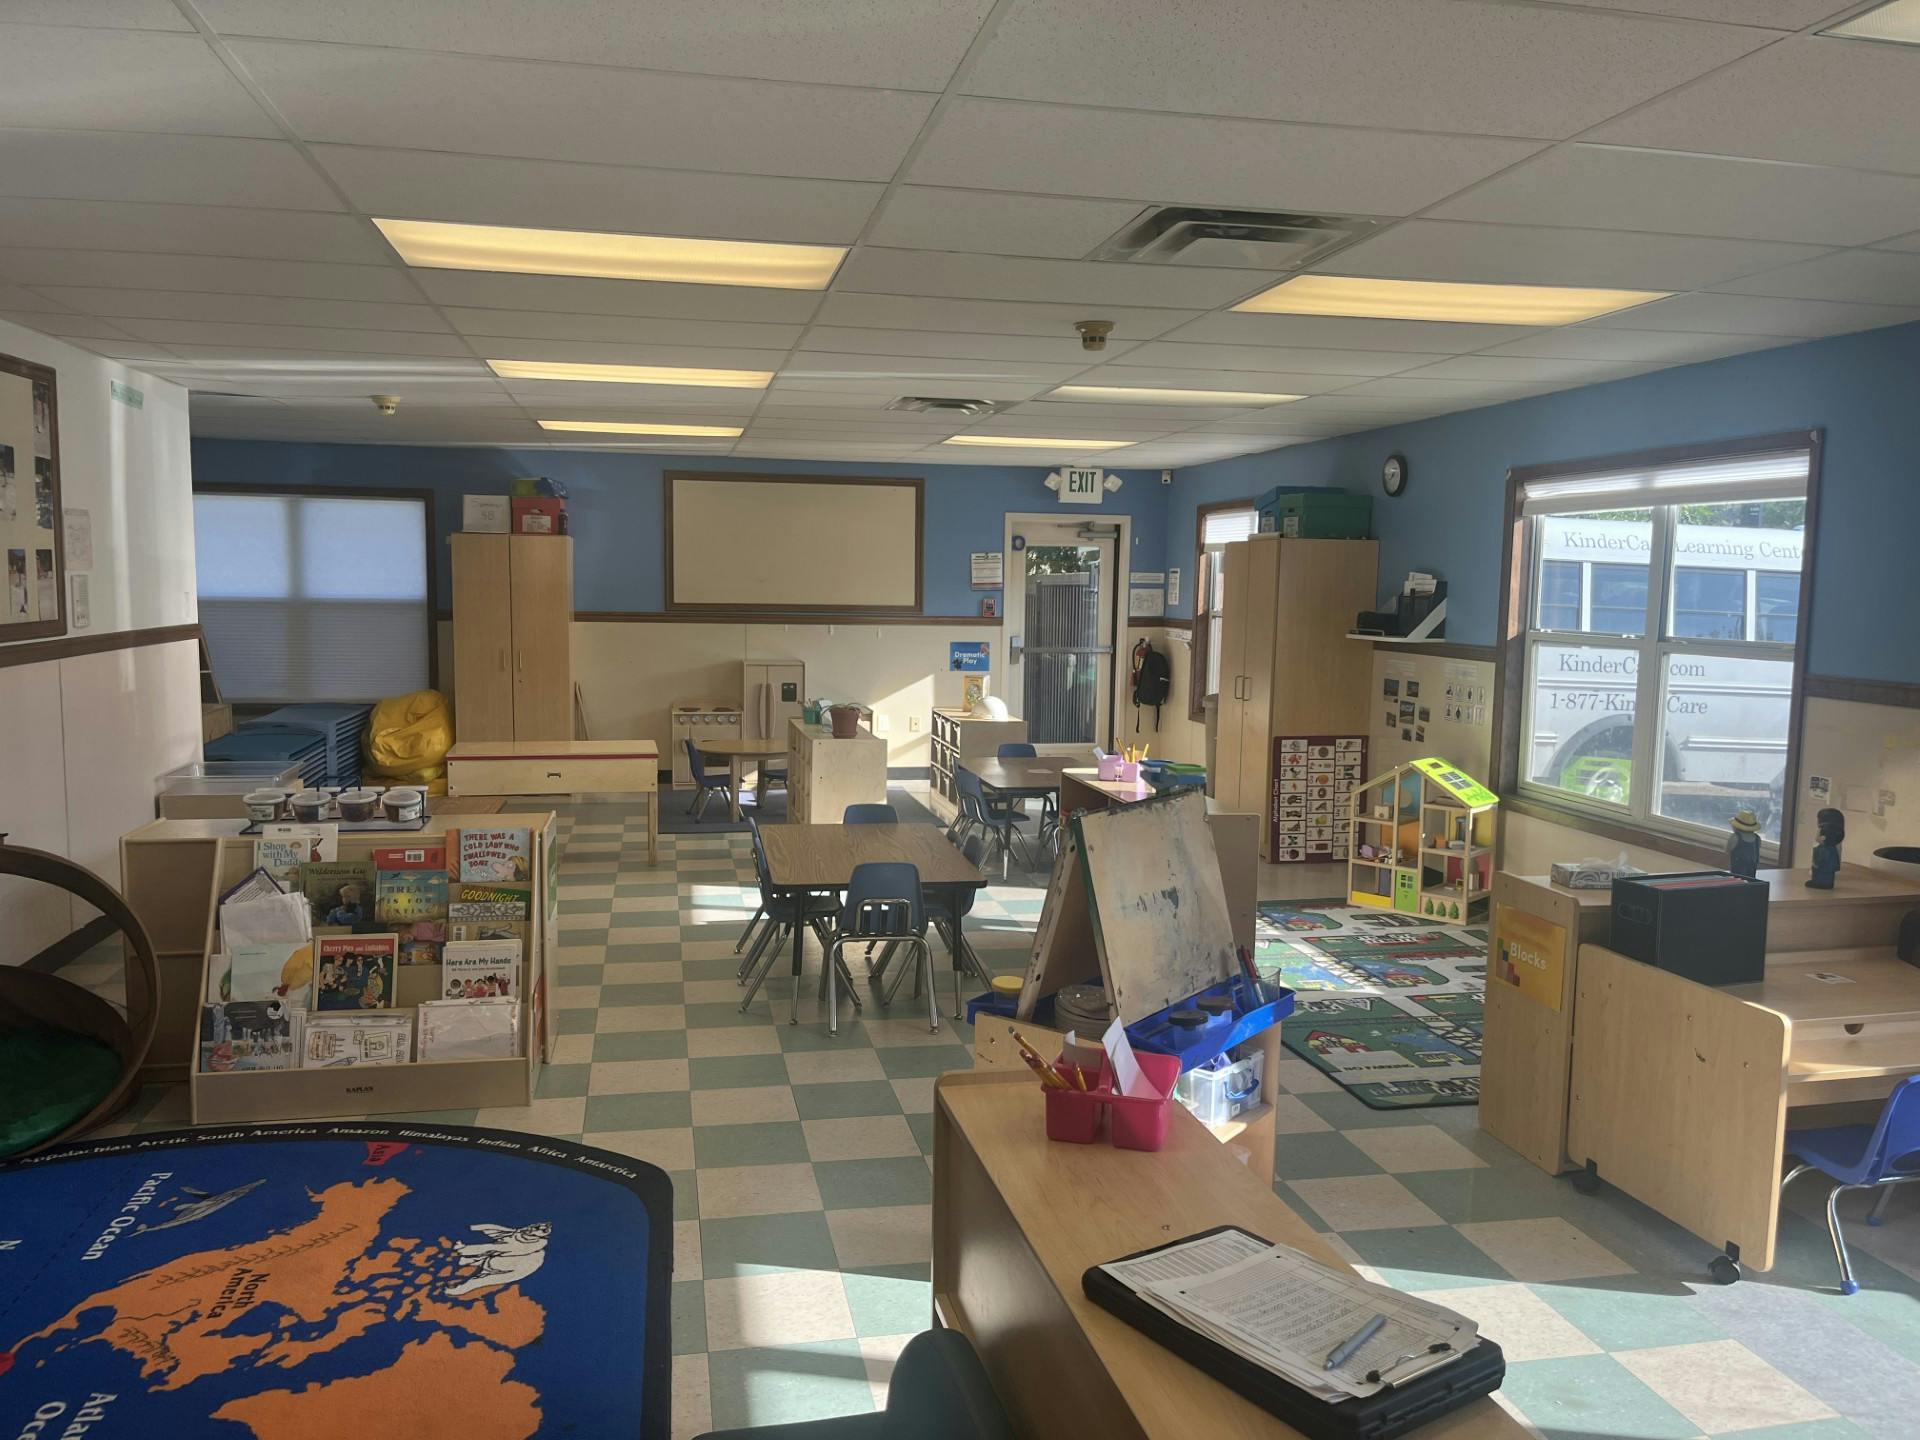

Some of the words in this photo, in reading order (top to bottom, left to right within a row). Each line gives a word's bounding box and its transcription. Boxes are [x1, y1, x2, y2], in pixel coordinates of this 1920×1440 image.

[1069, 471, 1096, 493] EXIT
[1563, 531, 1650, 551] KinderCa
[1675, 539, 1753, 560] Learning
[1760, 541, 1800, 559] Cent
[1560, 653, 1705, 676] KinderCcom
[1550, 692, 1708, 714] 1-877-KinCare
[264, 842, 286, 852] Shop
[464, 842, 483, 851] COLD
[485, 841, 503, 849] LADY
[504, 843, 519, 851] WHO
[263, 849, 282, 859] with
[284, 849, 298, 860] My
[464, 851, 506, 861] SWALLOWED
[461, 889, 519, 903] GOODNIGHT
[446, 958, 462, 966] Here
[479, 957, 488, 965] My
[490, 957, 511, 965] Hands
[1510, 942, 1547, 970] Blocks
[196, 1131, 244, 1141] South
[250, 1127, 317, 1137] America
[326, 1127, 390, 1135] Amazon
[399, 1129, 468, 1142] Himalayas
[138, 1136, 190, 1147] Arctic
[477, 1137, 520, 1149] Indian
[527, 1145, 567, 1159] Africa
[573, 1155, 637, 1179] Antarctica
[121, 1172, 173, 1213] Pacific
[81, 1216, 135, 1261] Ocean
[207, 1267, 250, 1319] America
[232, 1272, 270, 1309] North
